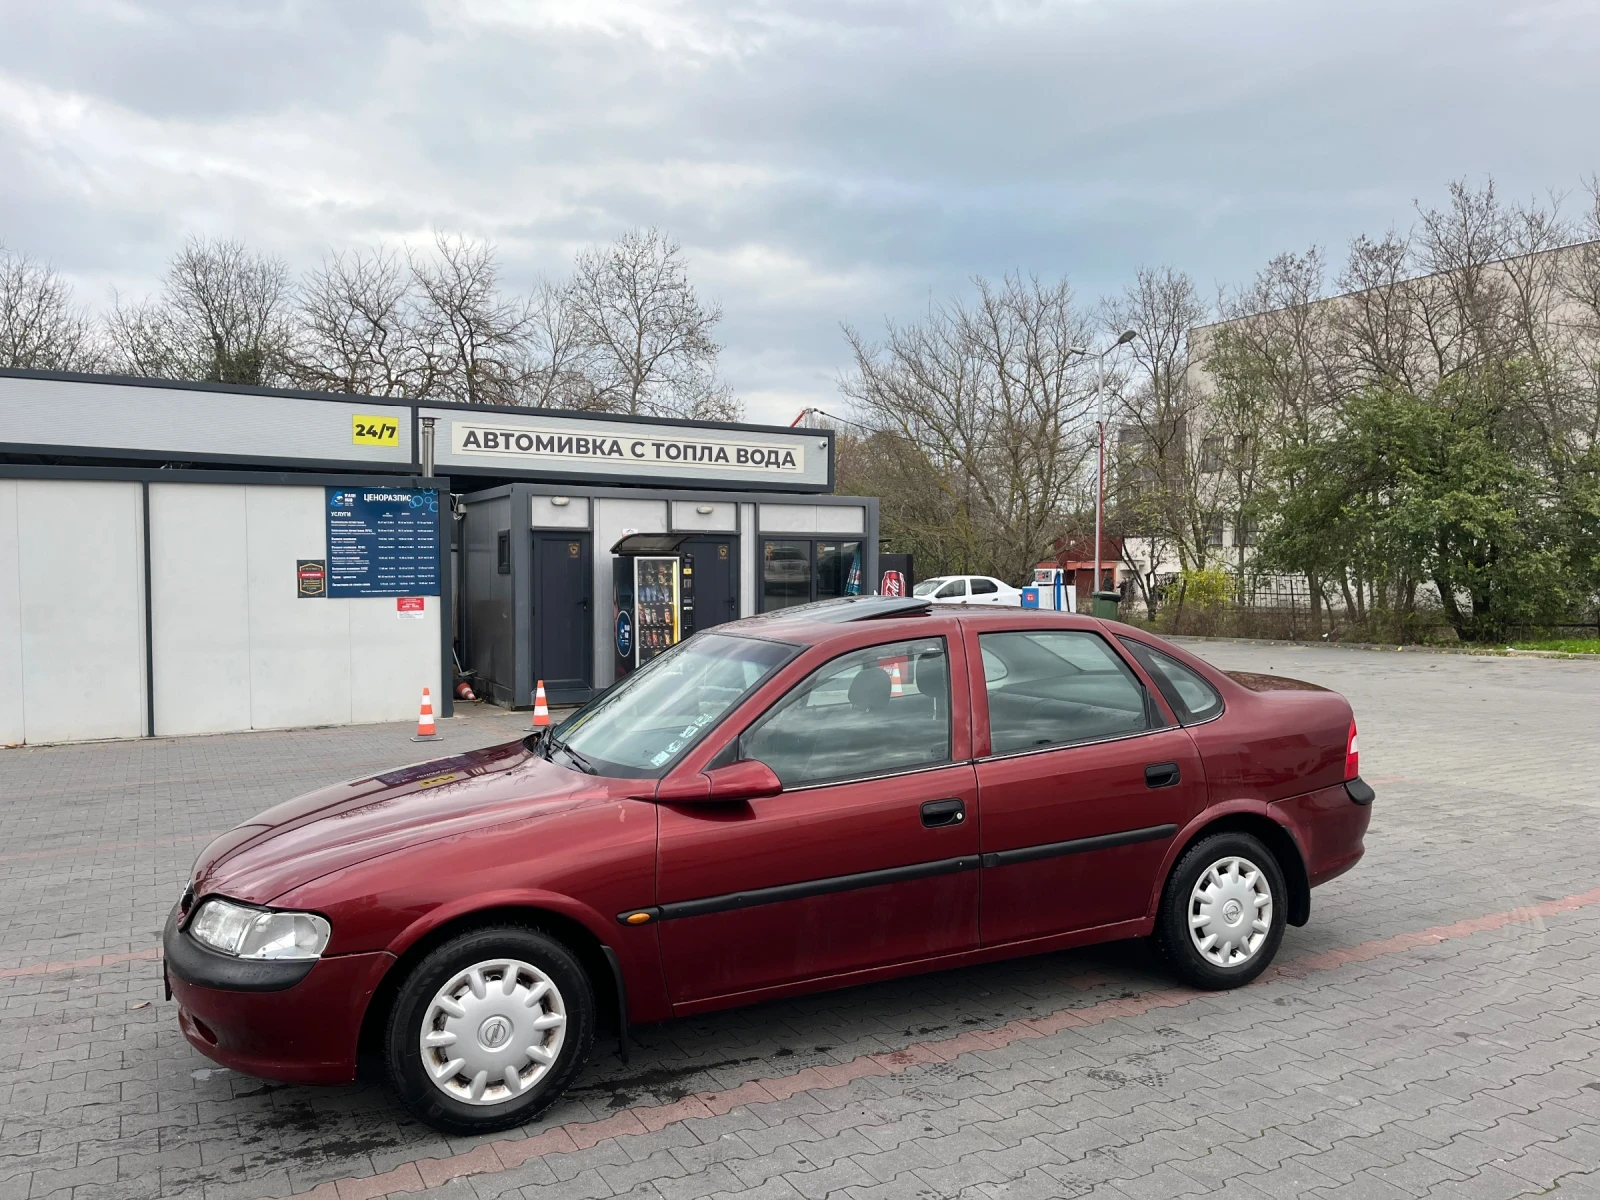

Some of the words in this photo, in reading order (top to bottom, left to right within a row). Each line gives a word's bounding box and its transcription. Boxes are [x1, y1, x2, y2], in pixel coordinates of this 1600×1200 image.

[355, 423, 396, 440] 24/7
[462, 430, 624, 458] АВТОМИВКА
[630, 441, 645, 458] С
[651, 442, 730, 463] ТОПЛА
[736, 448, 796, 469] ВОДА
[363, 493, 412, 502] ЦЕНОРАЗПИС
